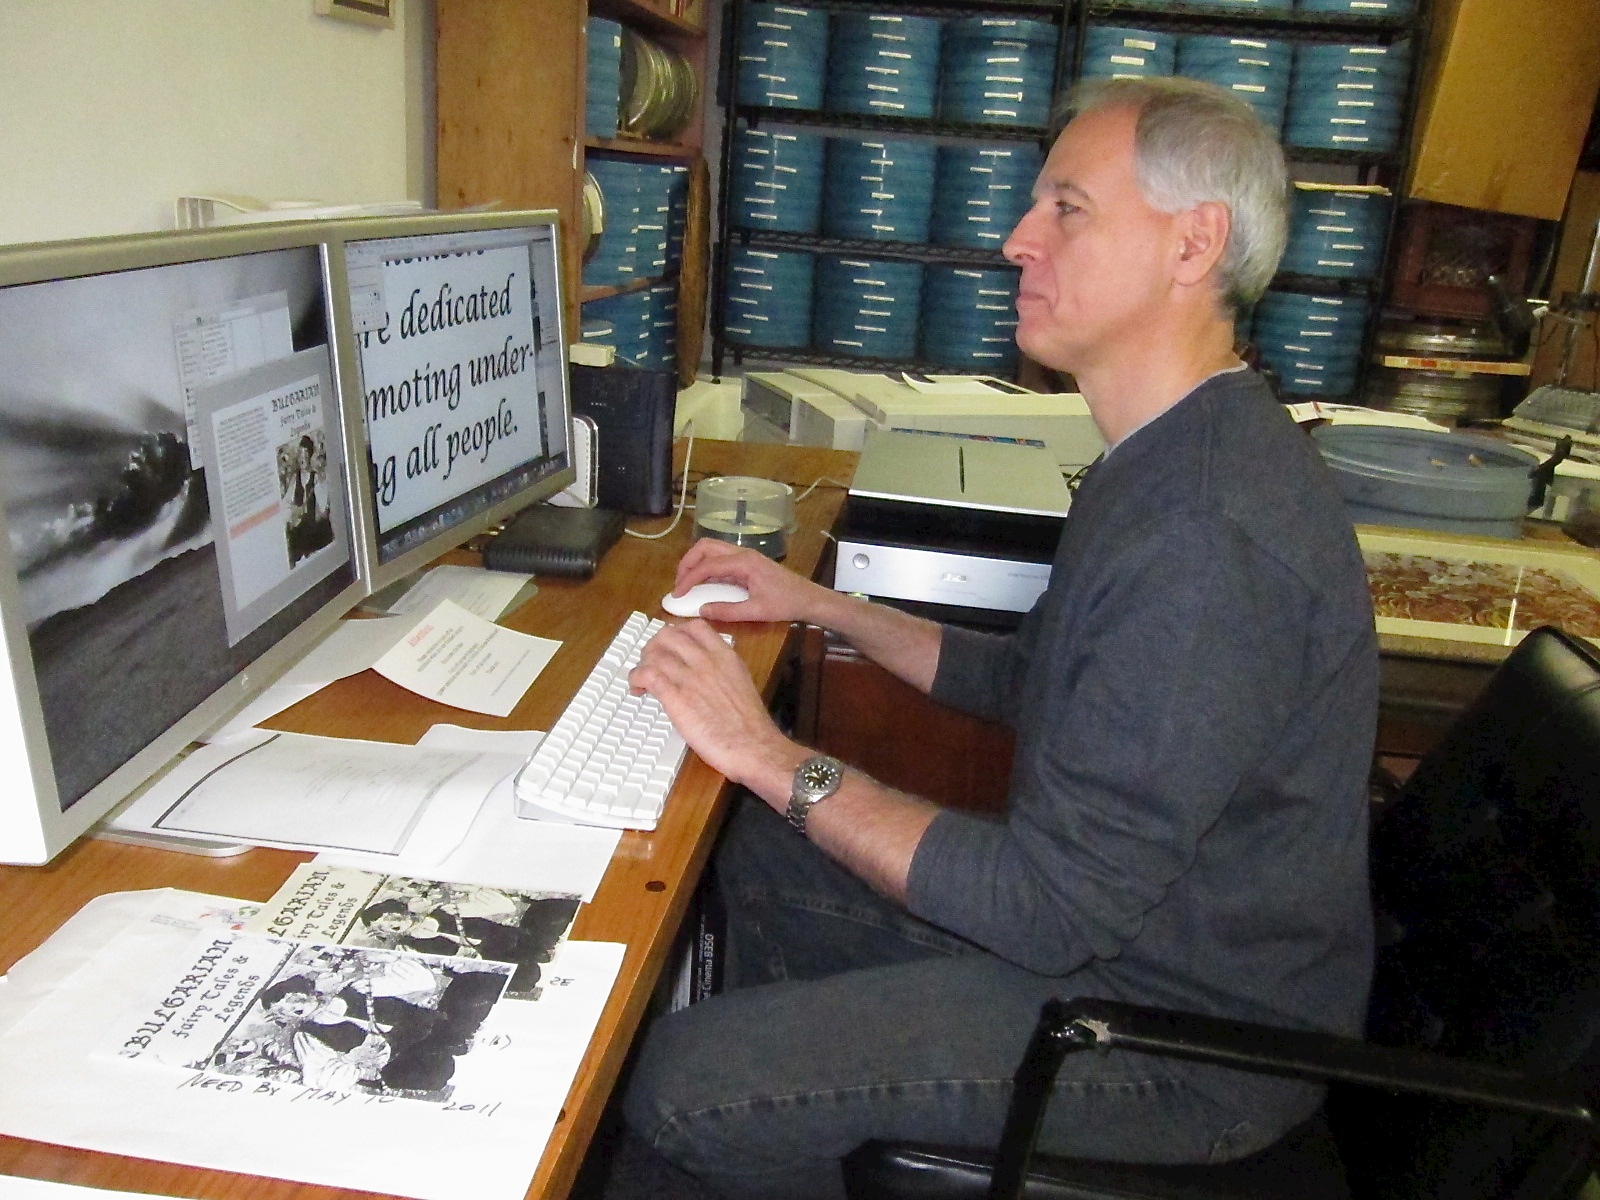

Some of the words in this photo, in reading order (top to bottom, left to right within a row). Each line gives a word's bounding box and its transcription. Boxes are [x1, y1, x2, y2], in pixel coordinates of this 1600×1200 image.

[400, 272, 515, 340] dedicated
[406, 423, 442, 479] all
[443, 398, 518, 480] people.
[306, 892, 338, 920] Tales
[321, 897, 358, 939] Legends
[703, 933, 714, 958] 8350
[123, 939, 233, 1049] BULGARIAN
[200, 967, 239, 1001] Tales
[232, 955, 249, 965] &
[702, 959, 713, 991] Cinema
[214, 974, 260, 1024] Legends
[177, 1072, 244, 1093] NEED
[290, 1087, 352, 1106] MAY
[442, 1102, 502, 1117] 2011
